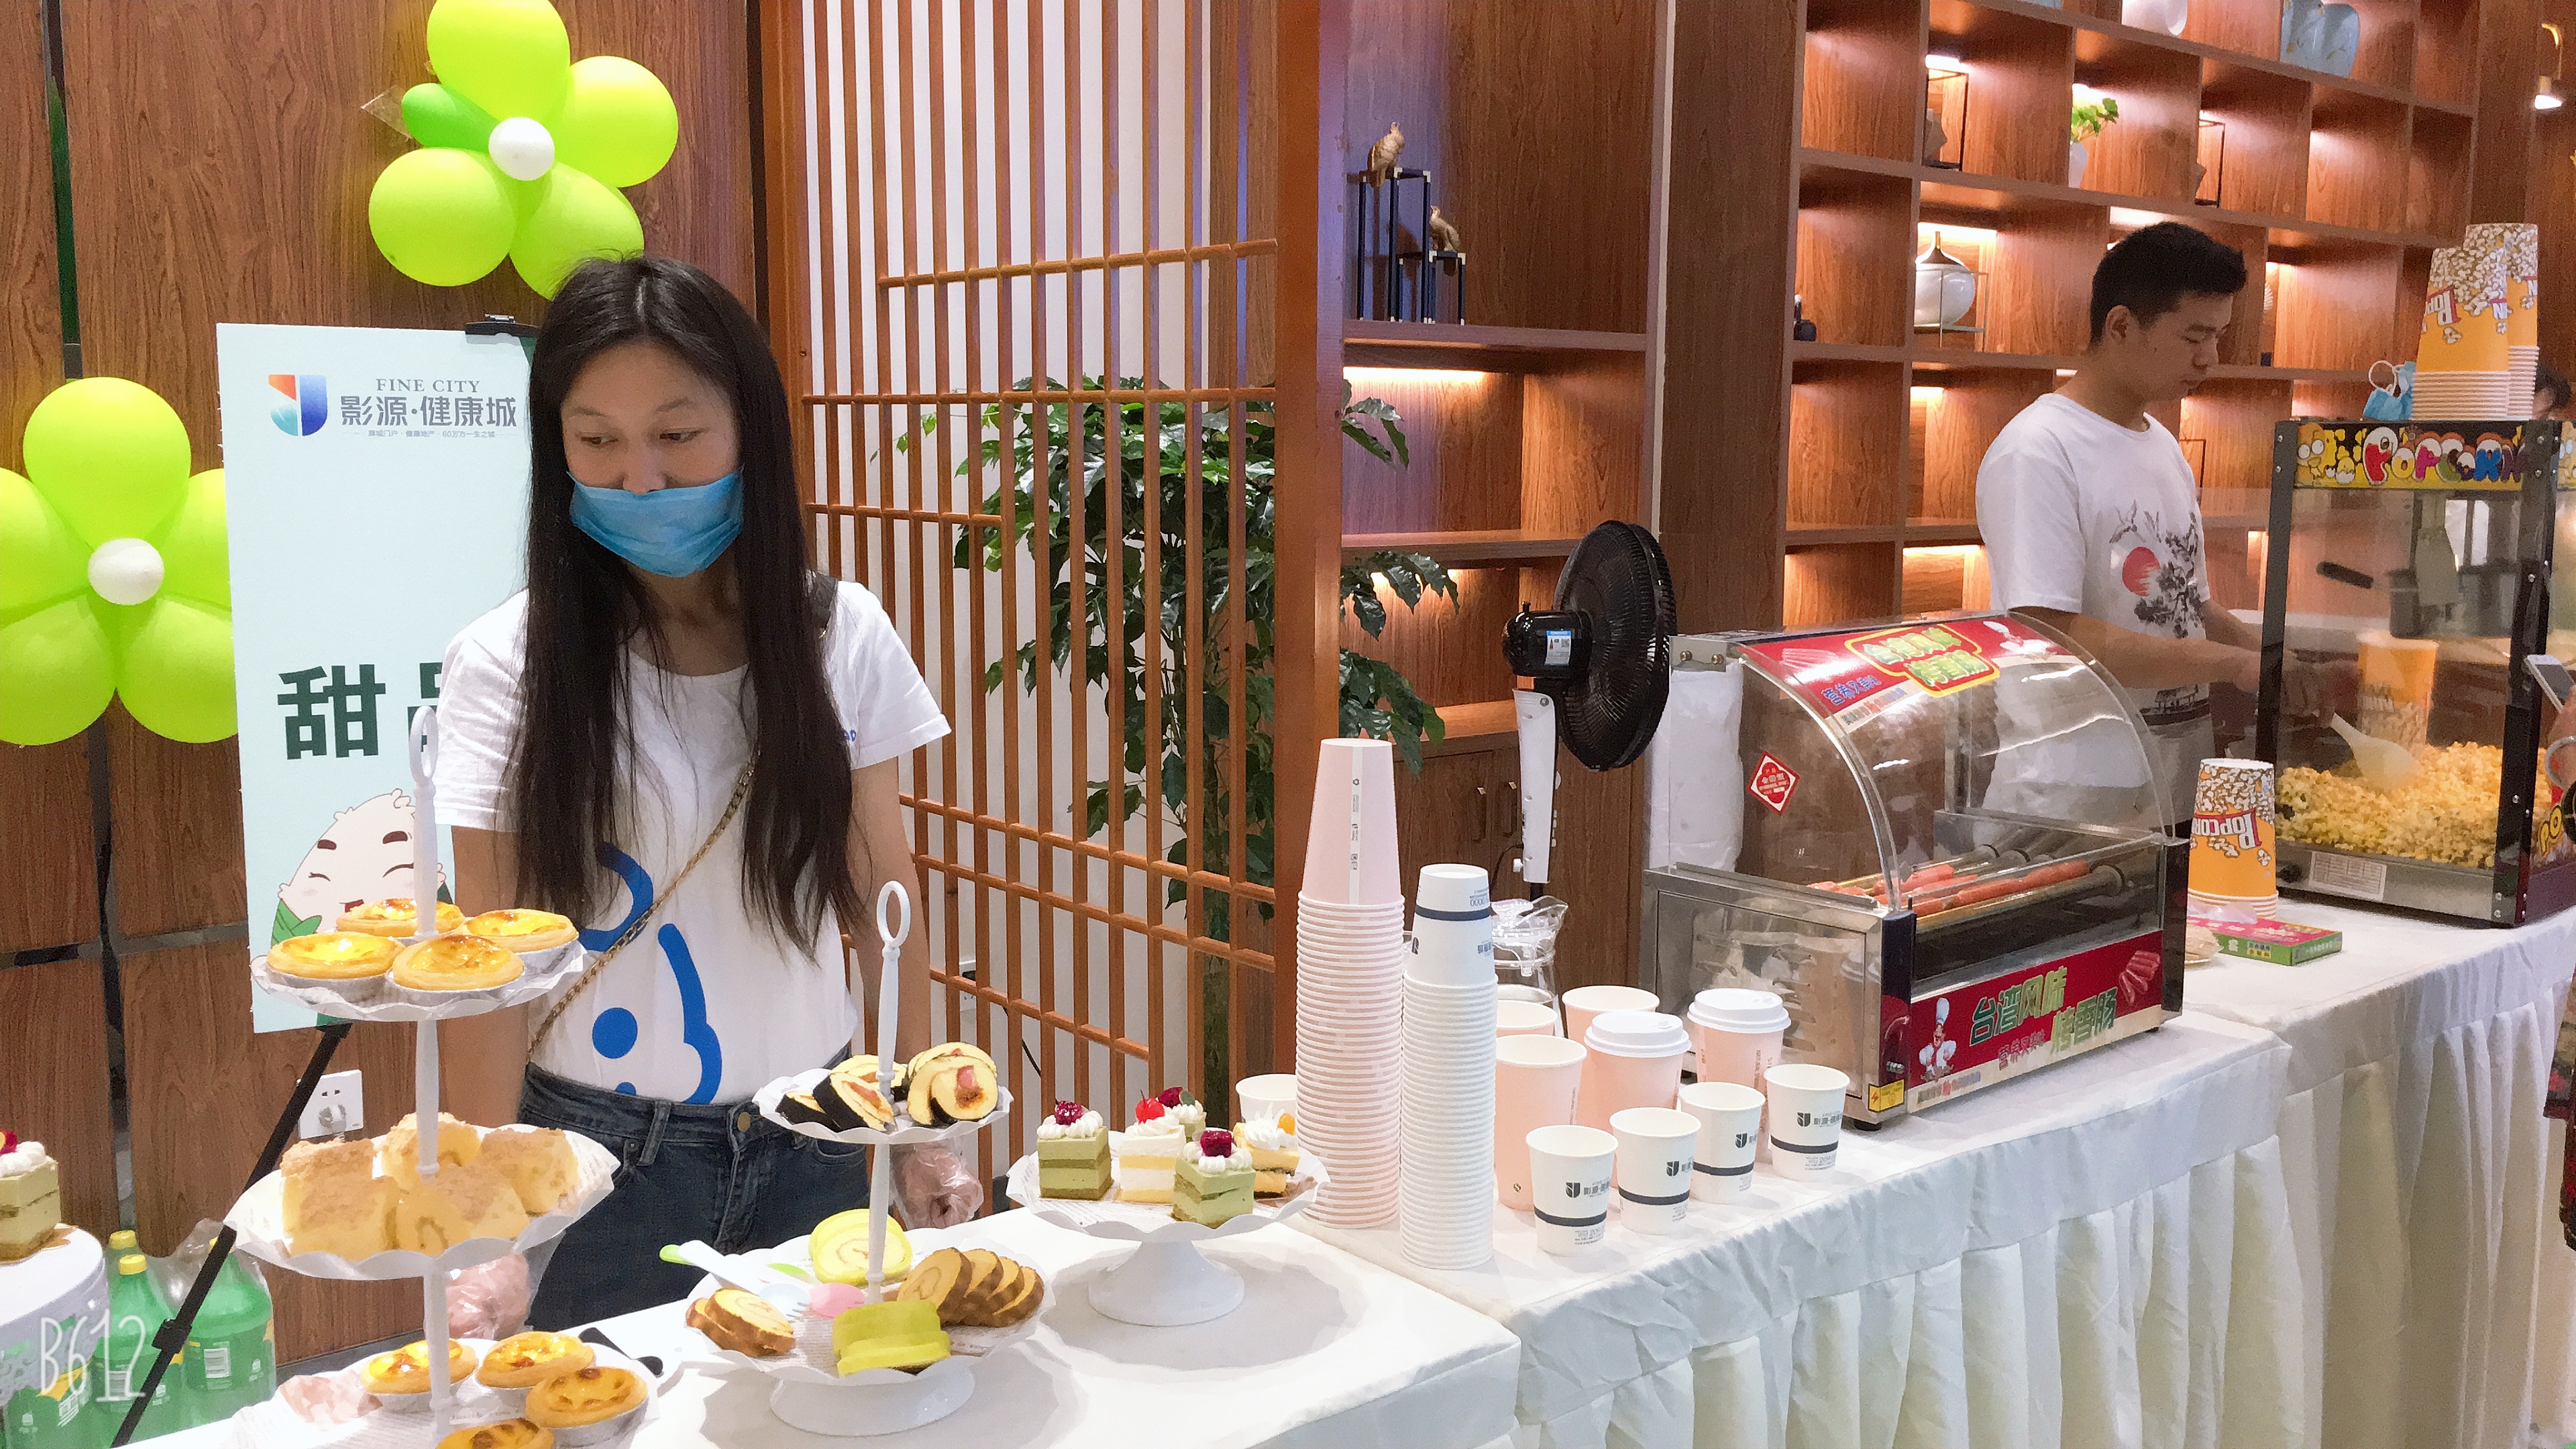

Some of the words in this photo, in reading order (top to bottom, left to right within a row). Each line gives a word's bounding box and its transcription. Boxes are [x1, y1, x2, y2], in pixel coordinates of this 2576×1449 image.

[376, 378, 425, 392] FINE
[432, 379, 480, 393] CITY
[1969, 965, 2068, 1046] 台湾风味
[2050, 986, 2118, 1055] 烤香肠
